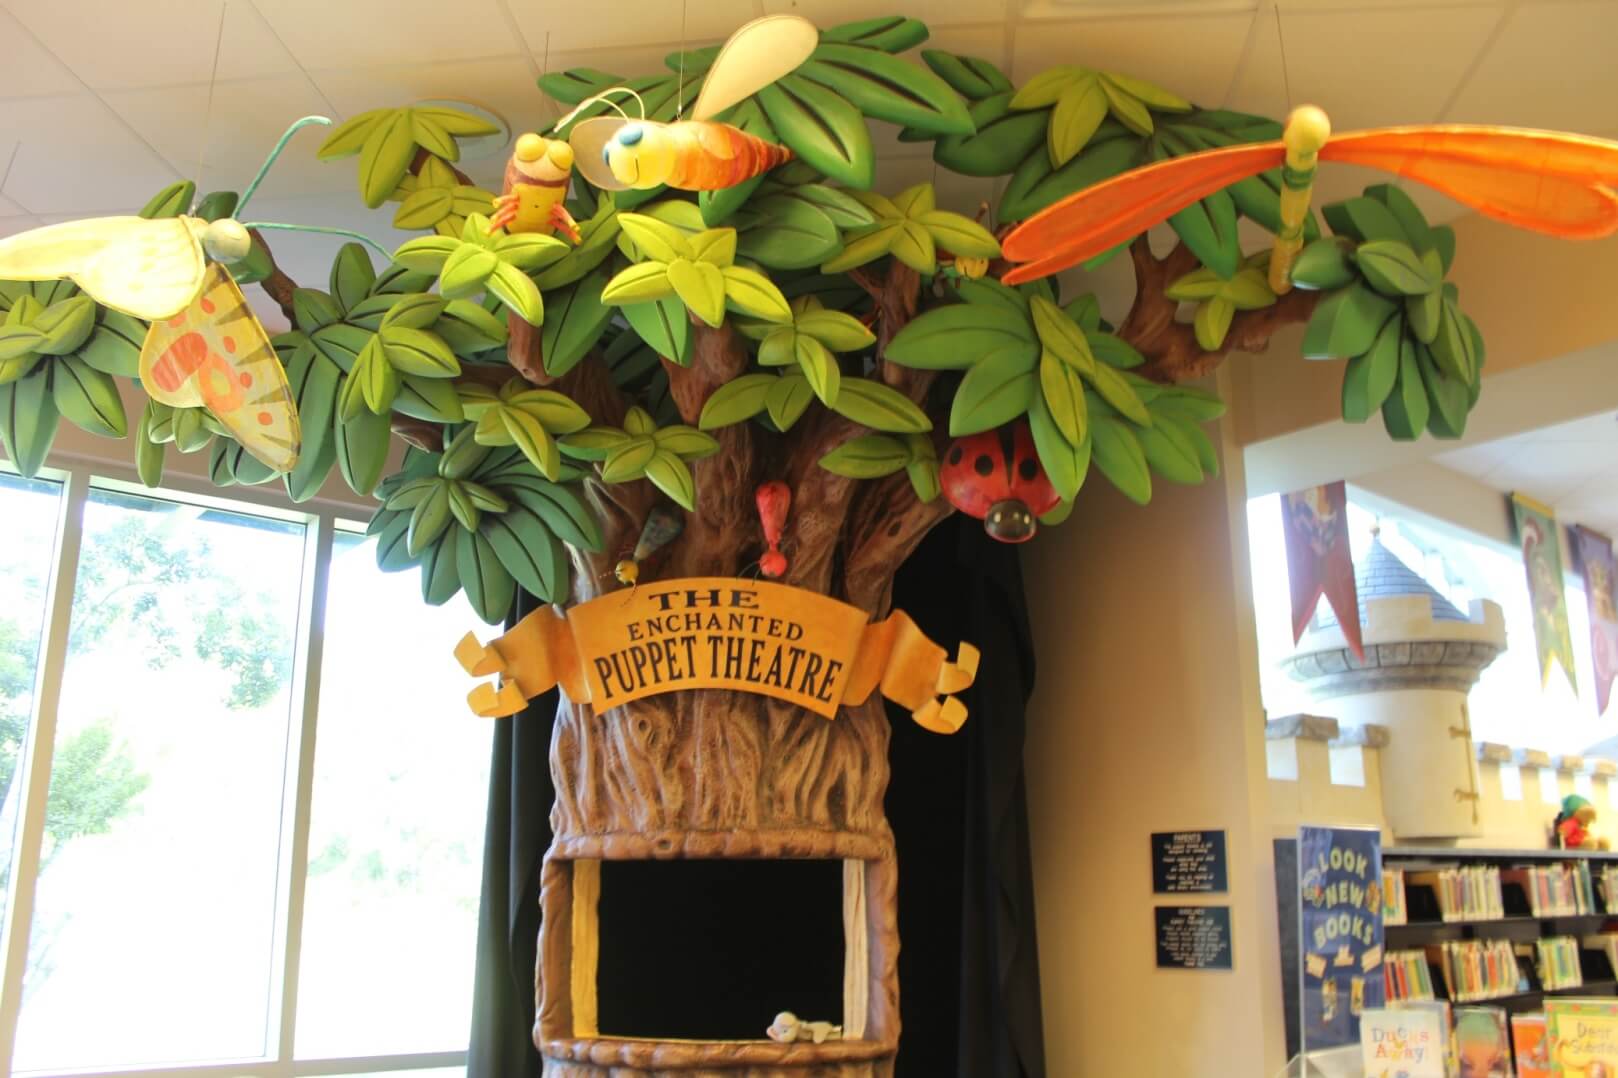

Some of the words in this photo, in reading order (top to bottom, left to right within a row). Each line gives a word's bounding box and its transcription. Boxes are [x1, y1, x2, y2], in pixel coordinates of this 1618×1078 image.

[649, 589, 760, 611] THE
[627, 613, 804, 642] ENCHANTED
[594, 635, 697, 699] PUPPET
[707, 635, 843, 704] THEATRE
[1318, 847, 1368, 880] LOOK
[1325, 880, 1364, 909] NEW
[1314, 912, 1373, 949] BOOKS
[1372, 1026, 1429, 1043] Ducs
